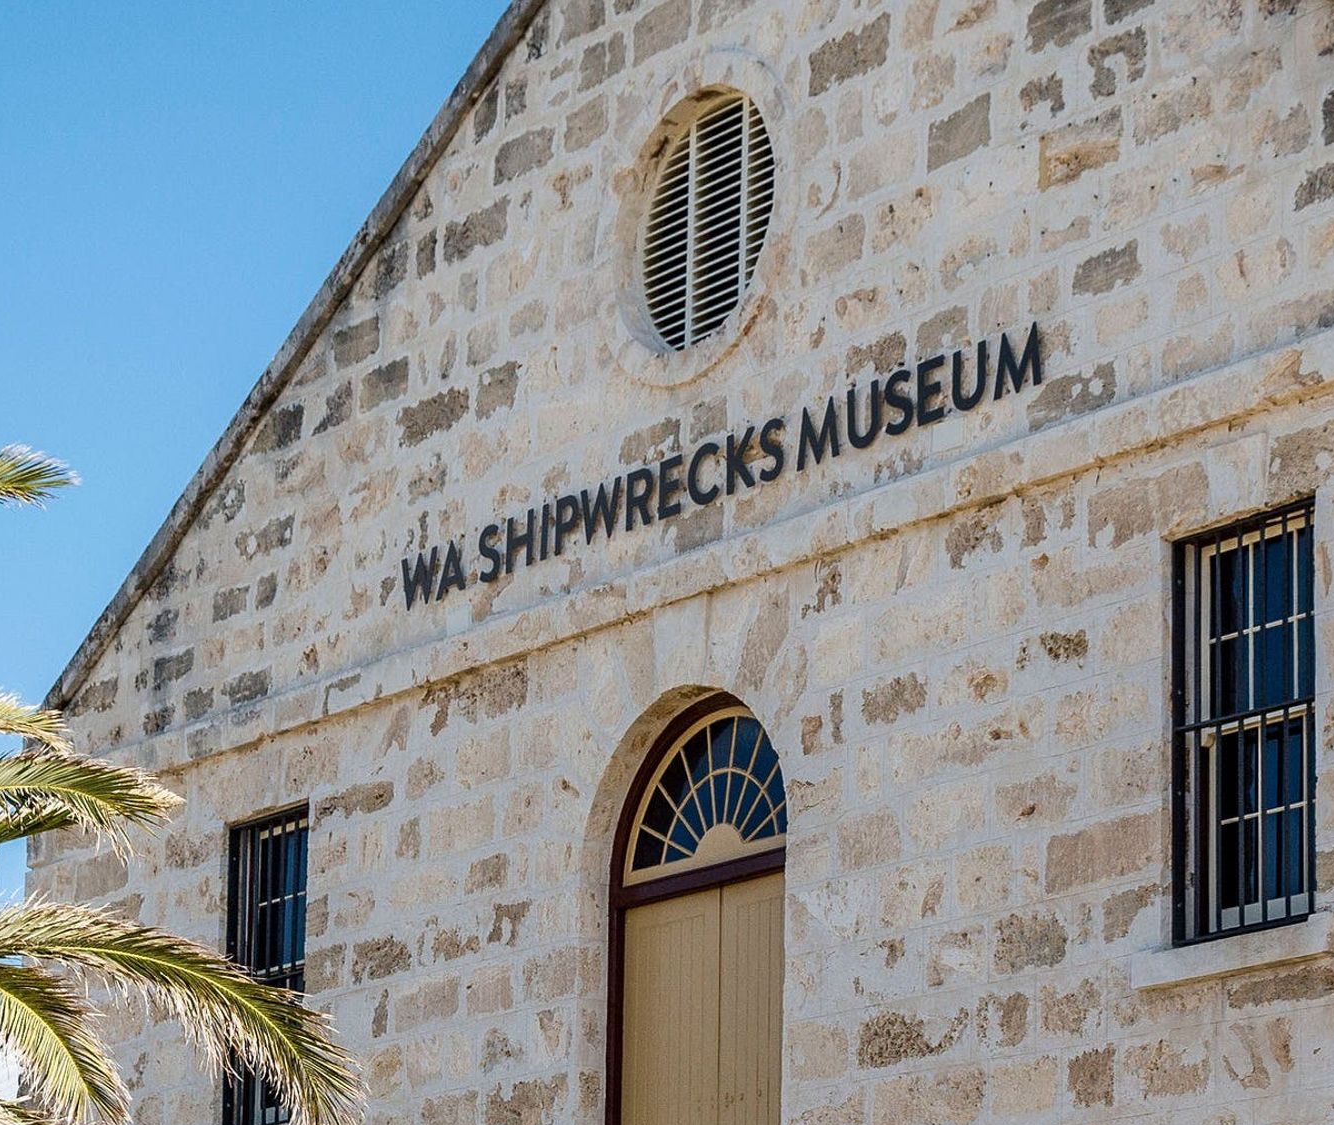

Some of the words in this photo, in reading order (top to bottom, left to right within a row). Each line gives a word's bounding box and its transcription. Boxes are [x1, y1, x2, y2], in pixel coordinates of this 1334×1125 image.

[401, 540, 467, 612] WA
[478, 417, 786, 584] SHIPWRECKS
[795, 321, 1045, 473] MUSEUM
